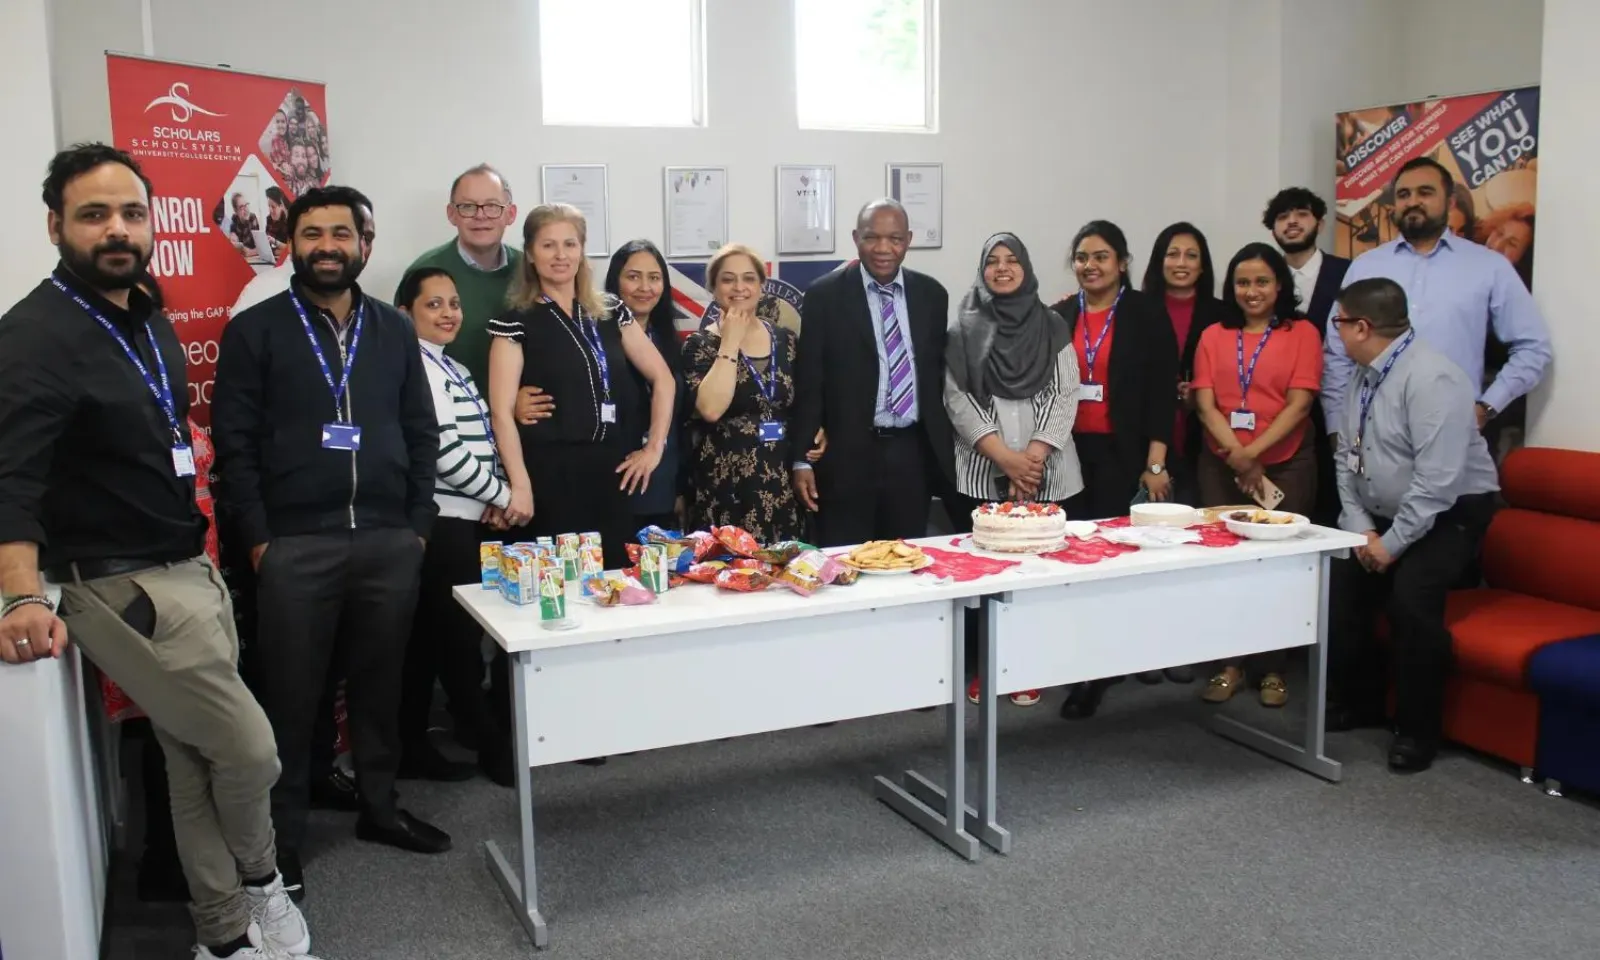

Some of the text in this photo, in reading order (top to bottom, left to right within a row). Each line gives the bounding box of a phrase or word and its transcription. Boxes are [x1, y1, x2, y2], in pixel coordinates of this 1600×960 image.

[1451, 93, 1518, 149] SEE WHAT
[153, 126, 221, 143] SCHOLARS
[1401, 129, 1416, 144] FOR
[1424, 123, 1441, 137] YOU
[132, 138, 241, 155] SCHOOL SYSTEM
[1346, 115, 1409, 168] DISCOVER
[1457, 108, 1529, 170] YOU
[132, 149, 179, 158] UNIVERSITY
[179, 152, 212, 160] COLLEGE
[1471, 135, 1536, 186] CAN DO
[152, 196, 211, 233] NROL
[166, 308, 189, 323] ging
[190, 308, 204, 319] the
[206, 306, 224, 318] GAP
